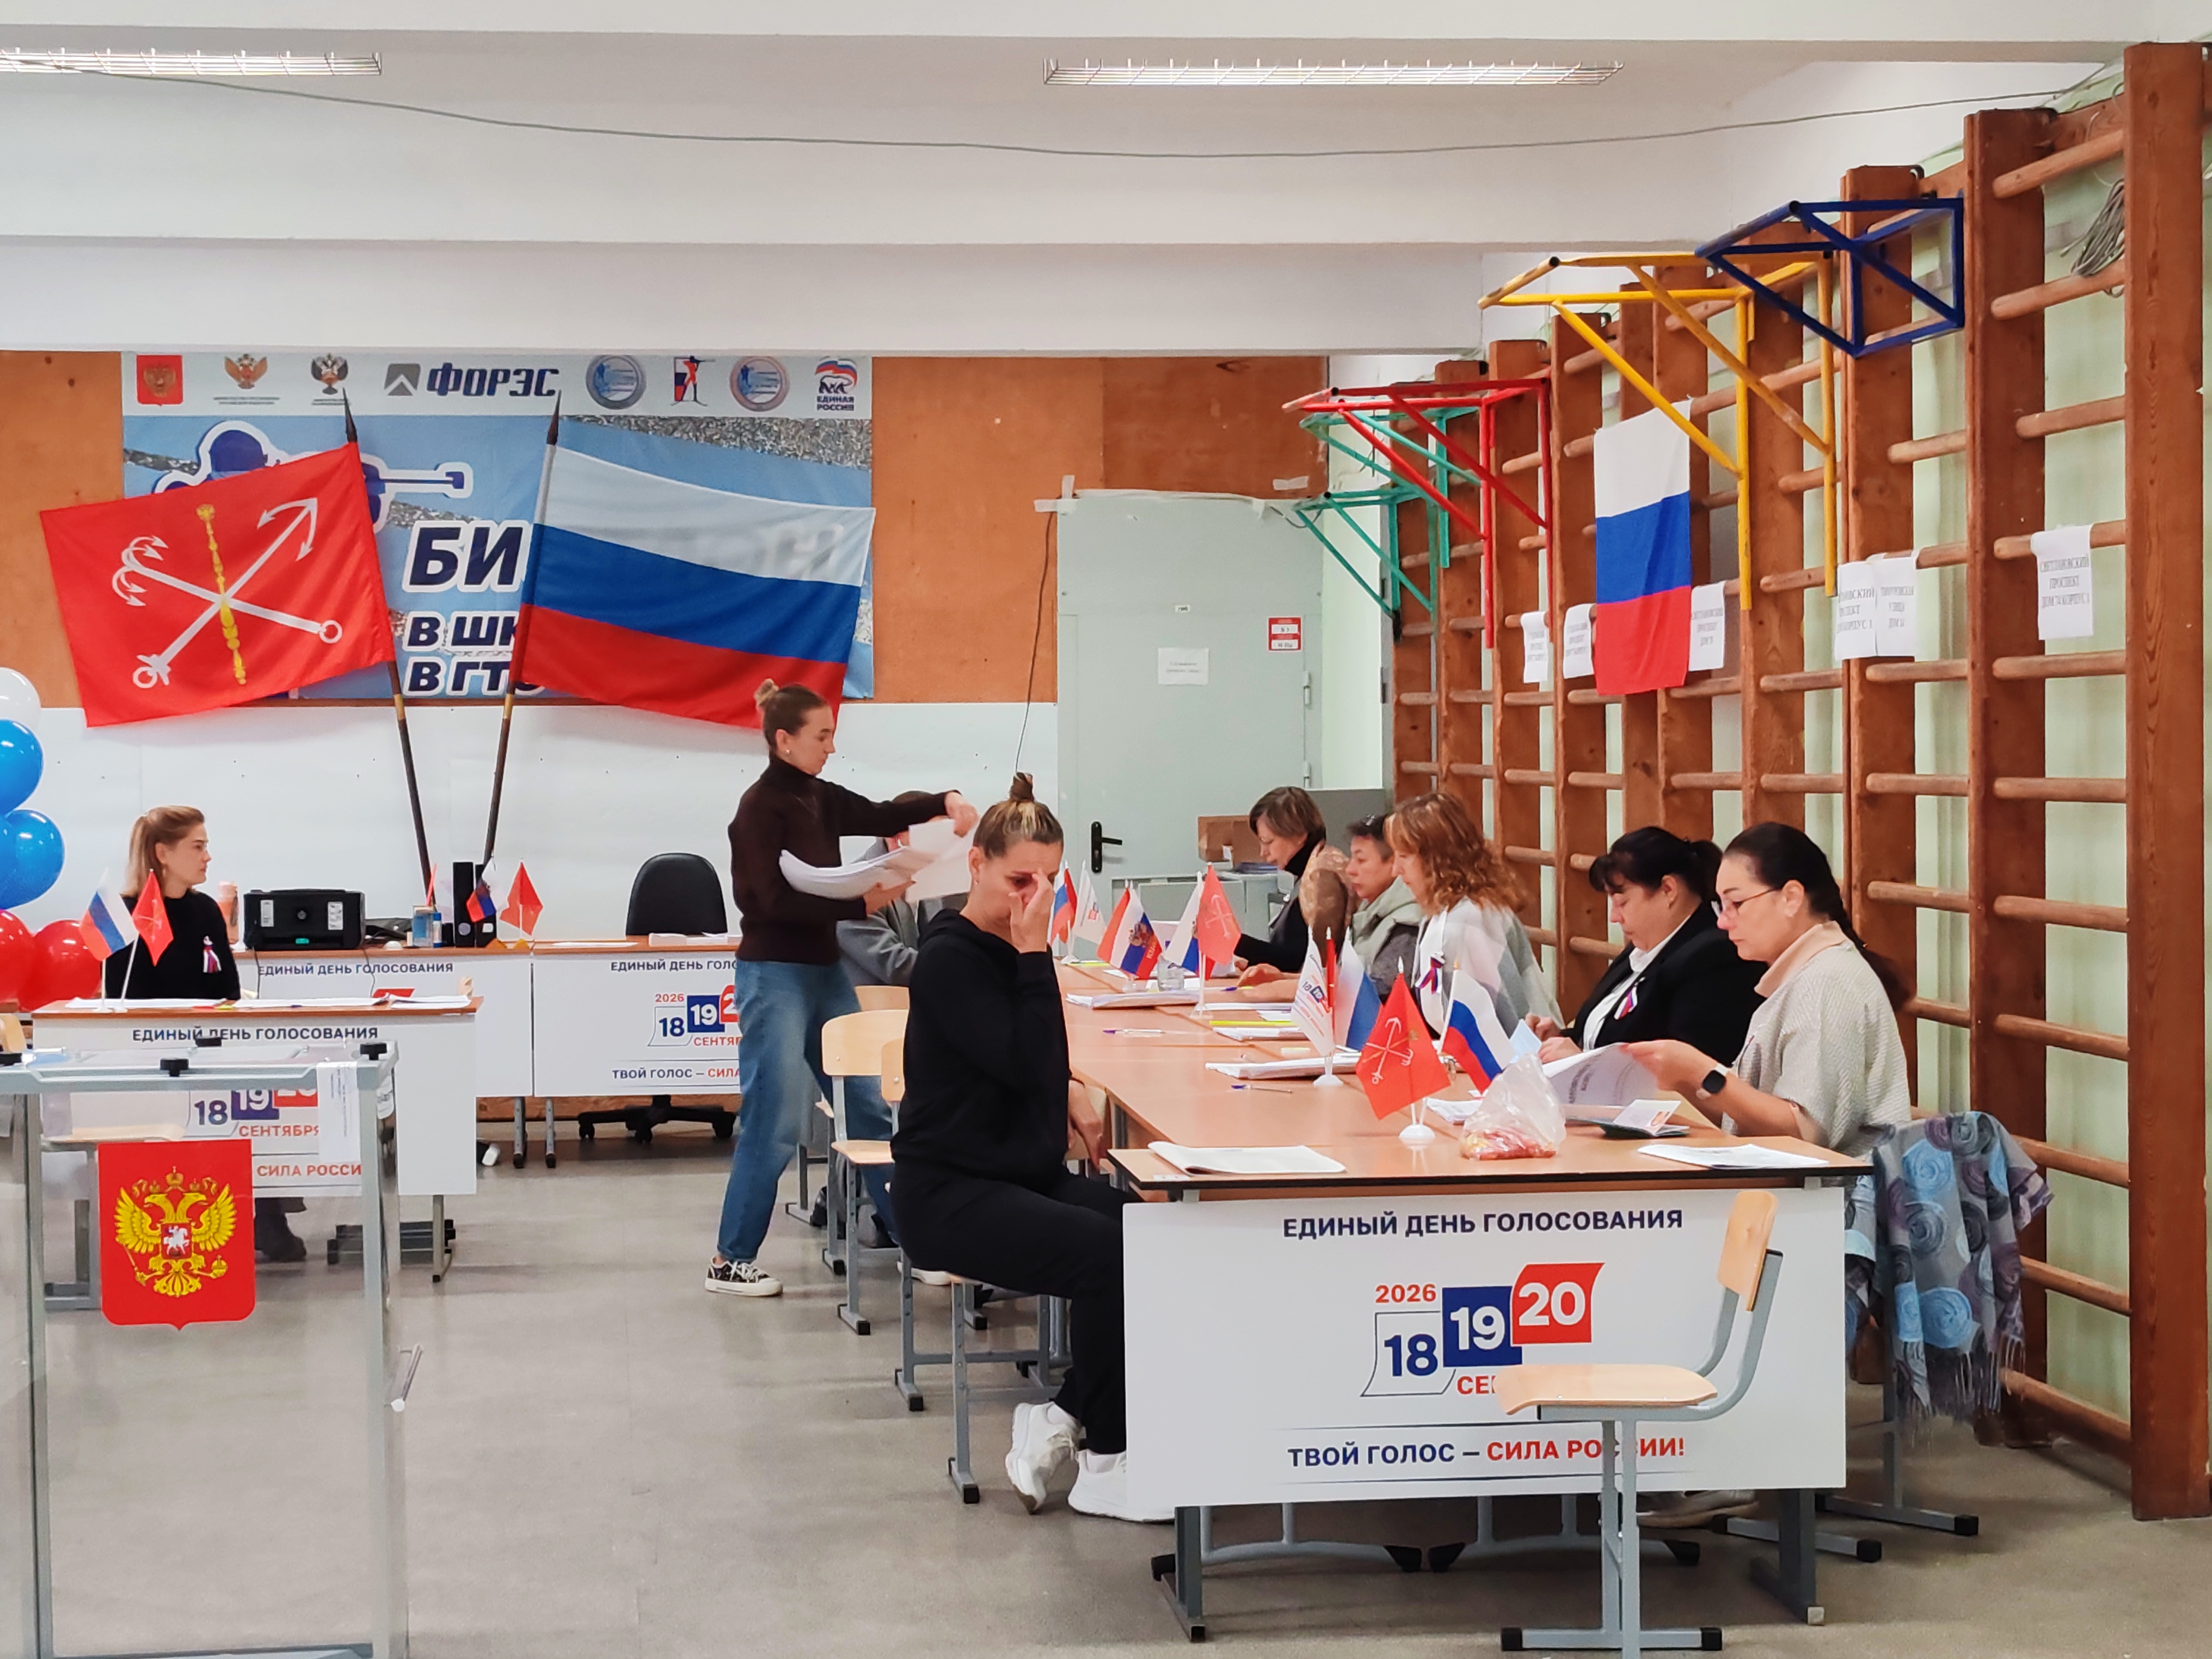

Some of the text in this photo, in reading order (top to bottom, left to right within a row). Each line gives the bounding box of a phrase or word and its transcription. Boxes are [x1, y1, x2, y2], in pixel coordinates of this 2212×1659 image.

[427, 362, 559, 396] ФОРЭС
[409, 526, 523, 586] БИ
[408, 616, 517, 647] В ШК
[408, 661, 441, 691] В
[259, 963, 453, 976] ЕДИНЫЙ ДЕНЬ ГОЛОСОВАНИЯ
[611, 959, 738, 972] ЕДИНЫЙ ДЕНЬ ГОЛО
[655, 994, 684, 1003] 2026
[659, 993, 738, 1037] 18 19 2
[133, 1025, 202, 1042] ЕДИНЫЙ
[256, 1027, 378, 1040] ГОЛОСОВАНИЯ
[694, 1036, 742, 1046] СЕНТЯ
[612, 1067, 646, 1079] ТВОЙ
[650, 1069, 692, 1079] ГОЛОС
[194, 1090, 269, 1125] 18 19
[257, 1164, 361, 1176] СИЛА РОССИ
[1283, 1209, 1682, 1240] ЕДИНЫЙ ДЕНЬ ГОЛОСОВАНИЯ
[1375, 1284, 1436, 1304] 2026
[1384, 1281, 1586, 1377] 18 19 20
[1457, 1375, 1496, 1394] СЕ
[1288, 1441, 1358, 1467] ТВОЙ
[1368, 1443, 1454, 1464] ГОЛОС
[1487, 1441, 1559, 1461] СИЛА
[1568, 1437, 1684, 1459] РОИИ!
